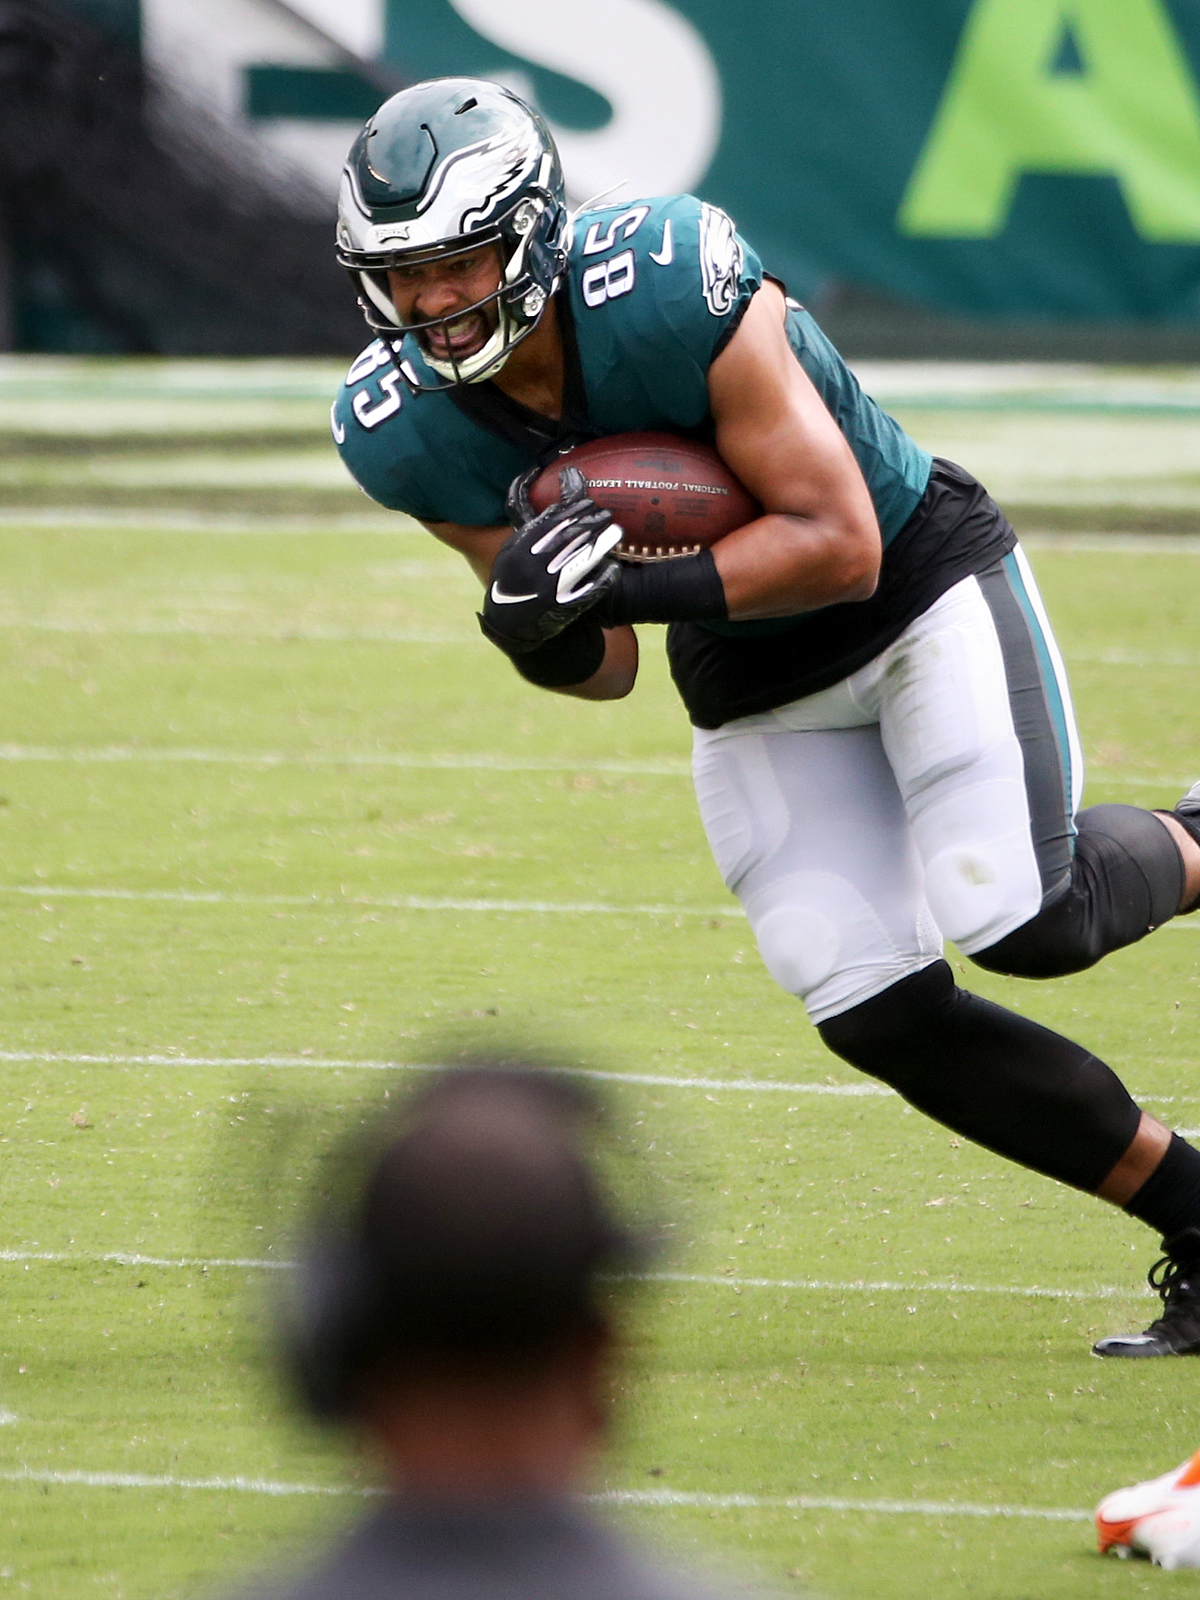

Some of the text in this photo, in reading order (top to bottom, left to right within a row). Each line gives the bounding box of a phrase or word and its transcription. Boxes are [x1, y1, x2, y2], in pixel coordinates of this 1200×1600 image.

[582, 204, 650, 308] 85
[625, 480, 679, 491] FOOTBALL
[682, 484, 729, 495] NATIONAL
